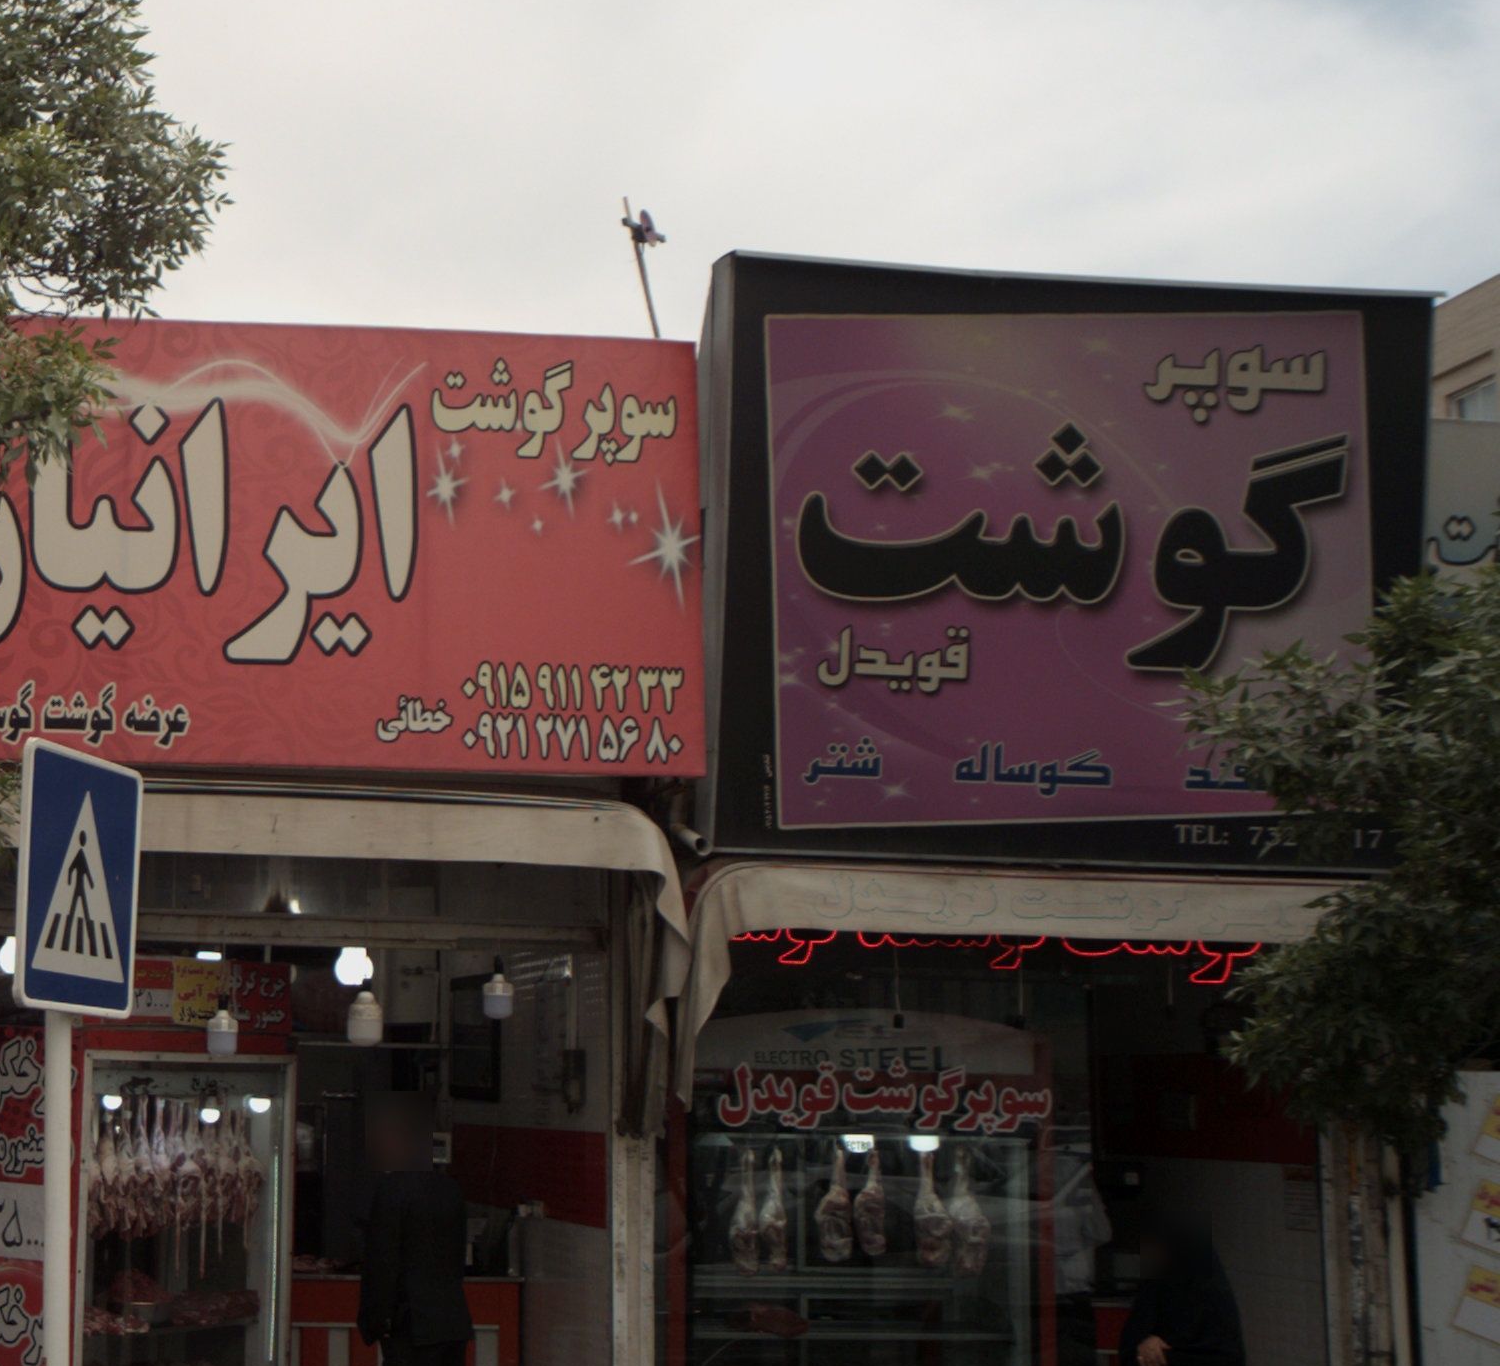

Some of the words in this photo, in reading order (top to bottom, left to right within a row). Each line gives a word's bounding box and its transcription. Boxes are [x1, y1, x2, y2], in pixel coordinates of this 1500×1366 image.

[431, 356, 574, 460] گوشت
[1144, 344, 1328, 423] سوپر
[572, 383, 677, 466] سوپر
[796, 422, 1350, 672] گوشت
[462, 660, 532, 710] ۰۹۱۵
[536, 662, 583, 711] ۹۱۱
[589, 663, 631, 713] ۴۲
[636, 666, 685, 714] ۳۳
[816, 624, 971, 693] قویدل
[41, 681, 118, 747] گوشت
[122, 690, 190, 748] عرضه
[462, 711, 530, 760] ۰۹۲۱
[535, 713, 591, 761] ۲۷۱
[597, 715, 640, 763] ۵۶
[645, 717, 684, 764] ۸۰
[803, 736, 883, 785] شتر
[954, 743, 1113, 796] گوساله
[1174, 825, 1230, 846] TEL:
[718, 1061, 840, 1129] قویدل
[841, 1055, 966, 1131] گوشت
[954, 1079, 1054, 1134] سوپر
